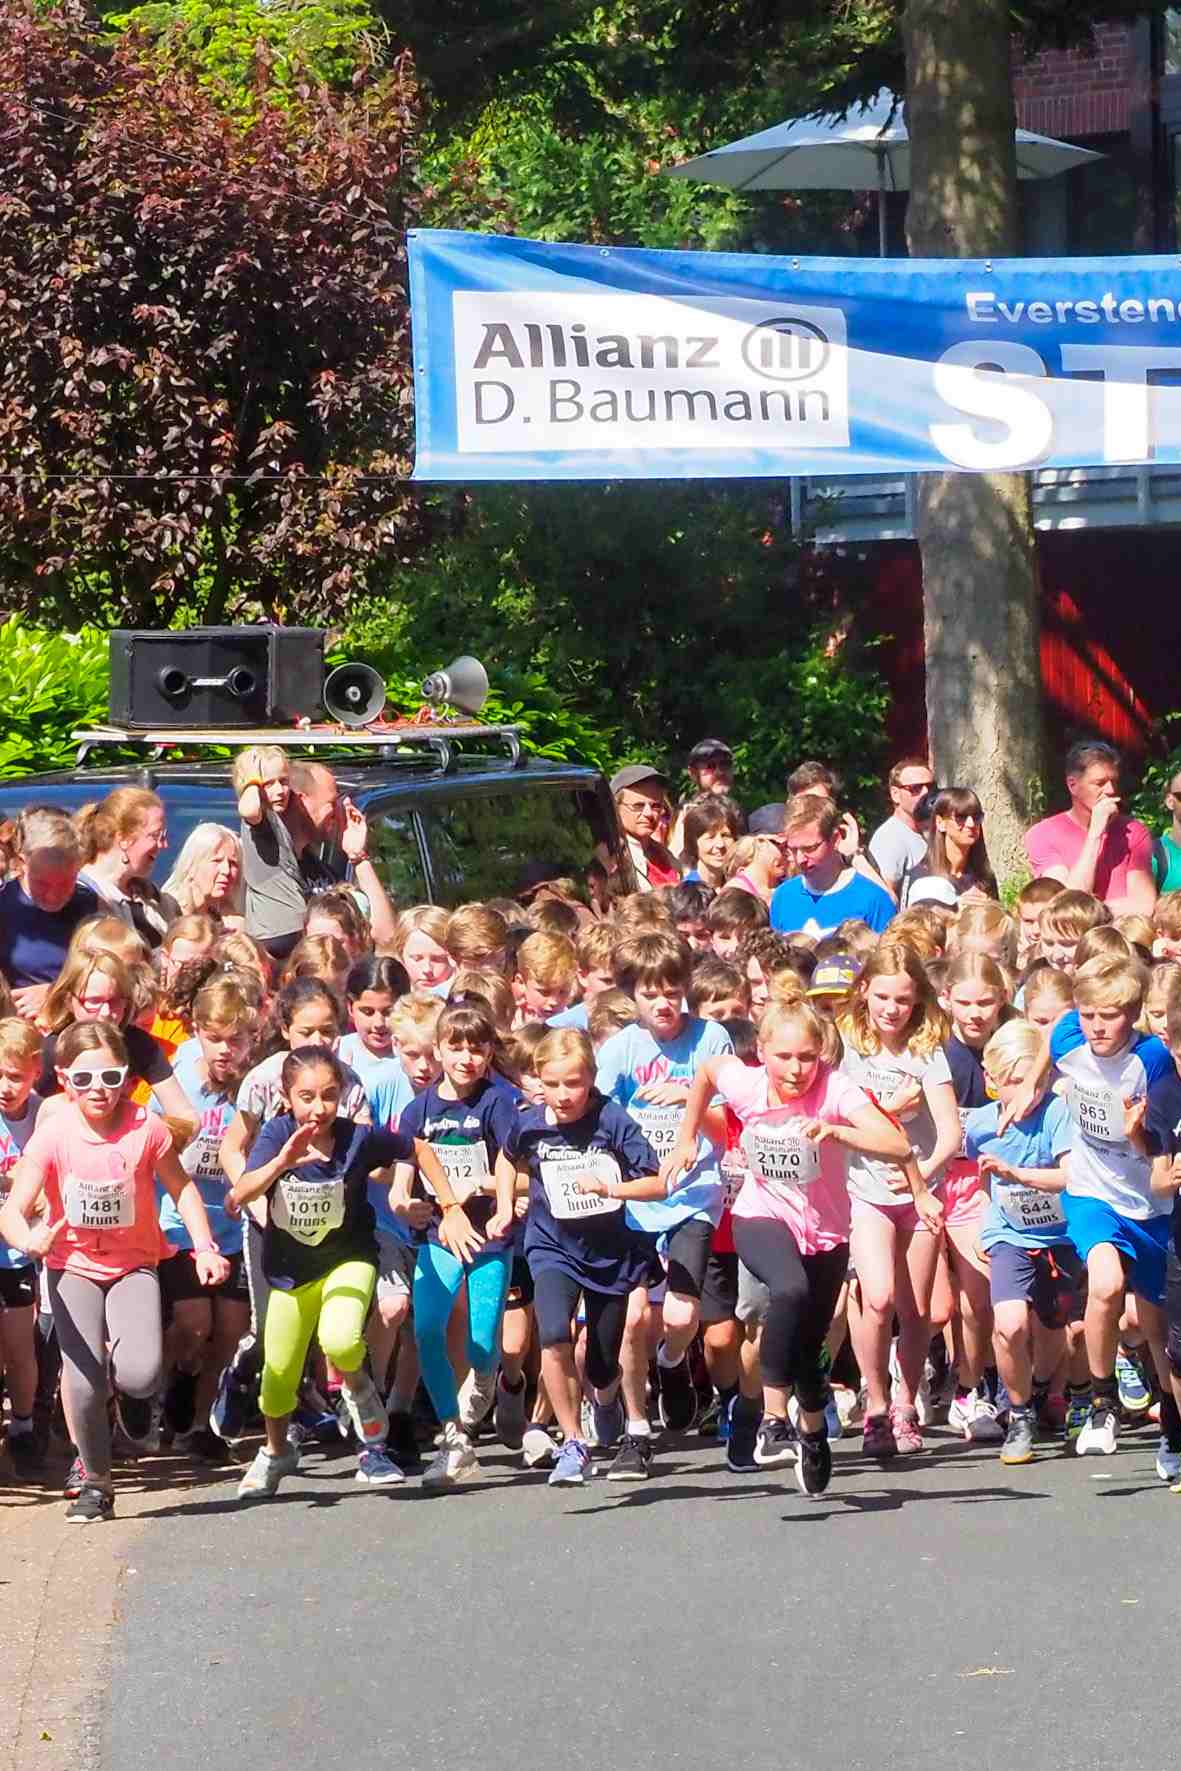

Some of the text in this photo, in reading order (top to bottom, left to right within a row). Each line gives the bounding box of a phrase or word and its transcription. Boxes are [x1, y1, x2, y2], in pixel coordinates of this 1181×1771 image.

[473, 322, 720, 369] Allianz
[473, 379, 830, 425] D. Baumann
[1080, 1102, 1107, 1121] 963
[1080, 1115, 1110, 1136] bruns
[643, 1129, 675, 1143] 792
[757, 1151, 800, 1166] 2170
[196, 1164, 224, 1176] brun
[761, 1165, 799, 1179] bruns
[79, 1199, 121, 1213] 1481
[289, 1200, 331, 1214] 1010
[567, 1198, 605, 1212] bruns
[1020, 1201, 1052, 1215] 644
[82, 1212, 120, 1225] bruns
[289, 1215, 328, 1227] bruns
